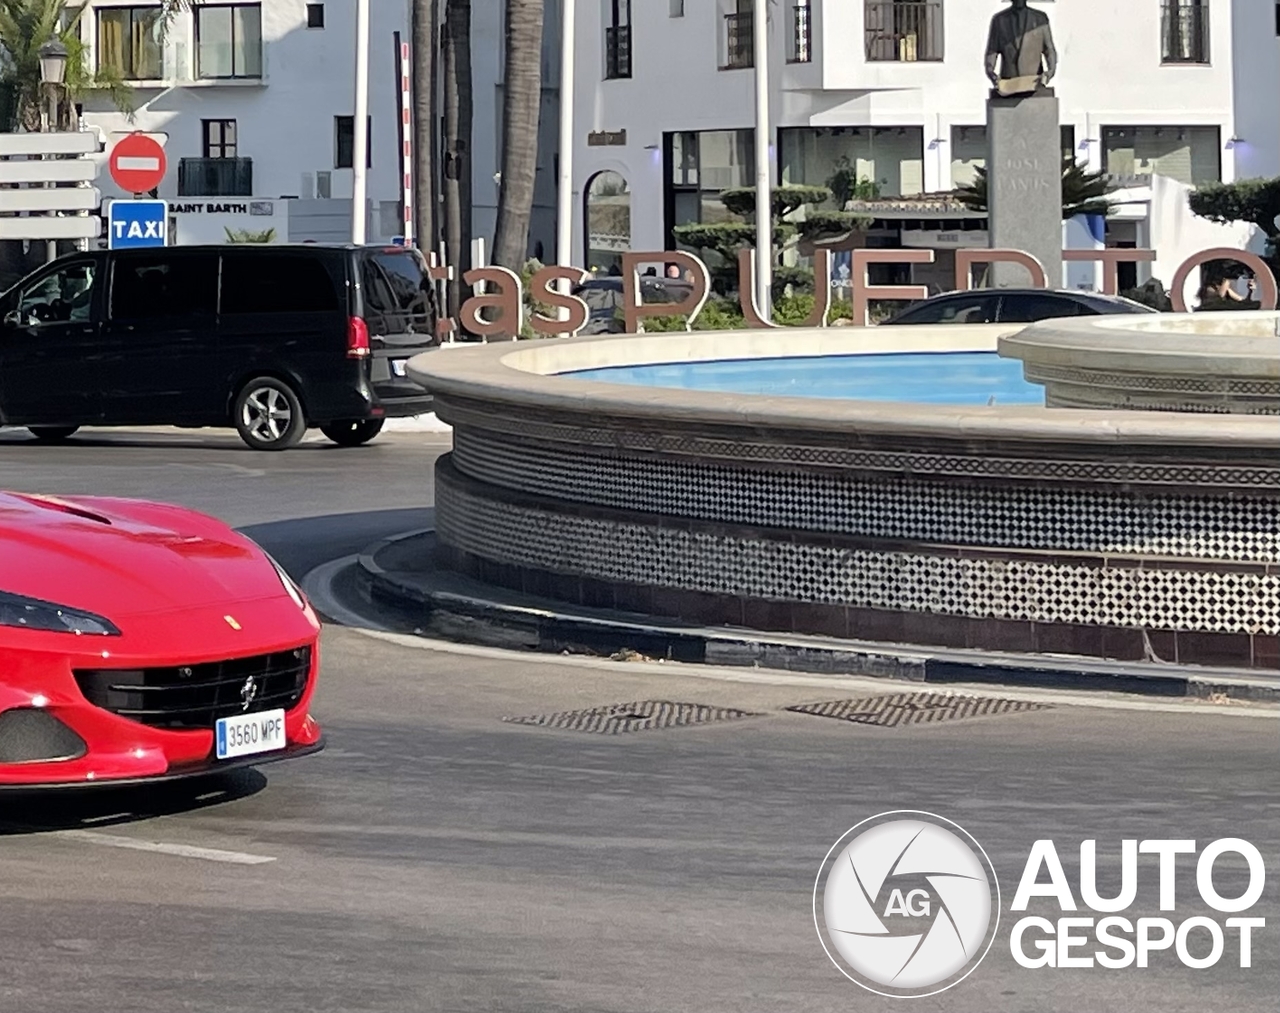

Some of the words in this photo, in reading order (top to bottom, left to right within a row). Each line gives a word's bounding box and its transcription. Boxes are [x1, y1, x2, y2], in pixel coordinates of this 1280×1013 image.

[206, 203, 247, 214] BARTH
[112, 220, 164, 238] TAXI
[229, 722, 259, 747] 3560
[261, 717, 282, 742] MPF
